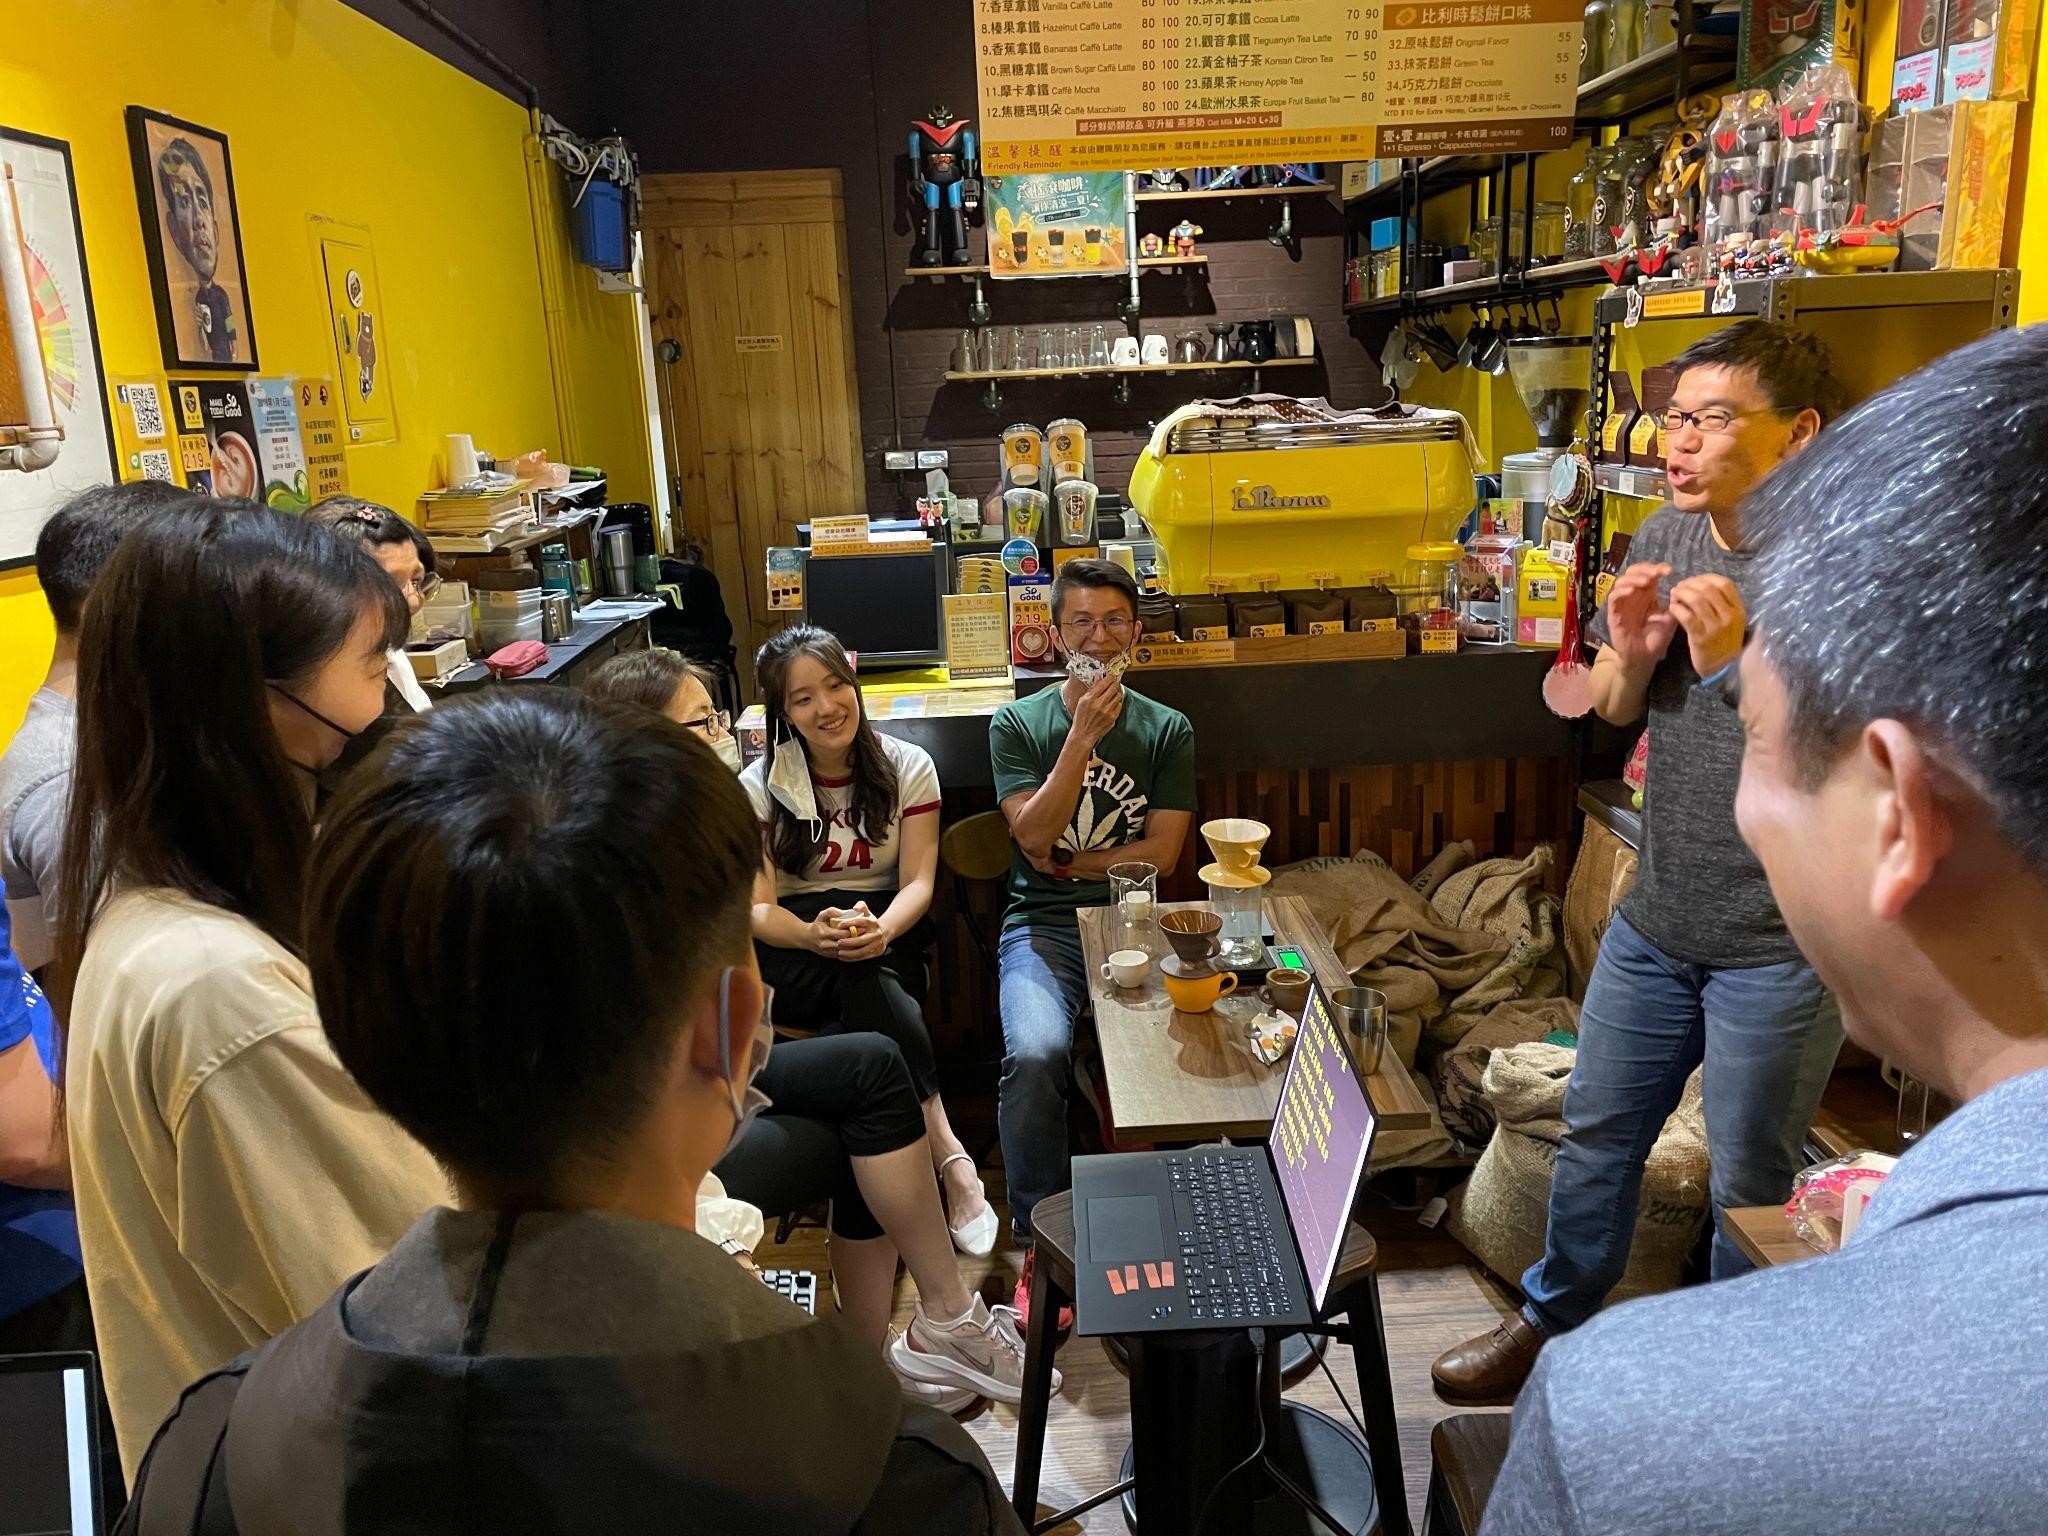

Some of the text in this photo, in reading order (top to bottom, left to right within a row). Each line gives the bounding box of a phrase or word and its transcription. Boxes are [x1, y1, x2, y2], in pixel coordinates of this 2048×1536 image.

[1347, 9, 1379, 19] 70 90
[1421, 4, 1532, 25] 比利時鬆餅口味
[1142, 17, 1179, 28] 80 100
[1185, 13, 1251, 26] 20.可可拿鐵
[1254, 15, 1300, 24] Cocoa Latte
[1043, 23, 1078, 32] Hazelnut
[1103, 21, 1122, 30] Latte
[1313, 34, 1332, 42] Latte
[1346, 30, 1378, 41] 70 90
[1558, 32, 1571, 42] 55
[983, 42, 1041, 56] 9.香蕉拿鐵
[1044, 45, 1077, 54] Bananas
[1103, 43, 1122, 51] Latte
[1142, 39, 1179, 49] 80 100
[1455, 39, 1486, 49] Original
[1185, 54, 1262, 68] 22.黃金柚子茶
[1265, 56, 1292, 65] Korean
[1295, 56, 1317, 64] Citron
[1364, 51, 1377, 61] 50
[1556, 53, 1569, 63] 55
[1142, 60, 1179, 70] 80 100
[1454, 59, 1494, 68] Green Tea
[1051, 66, 1073, 74] Brown
[1075, 65, 1095, 76] Sugar
[1118, 63, 1136, 72] Latte
[1362, 72, 1376, 81] 50
[1555, 73, 1568, 83] 55
[1142, 81, 1179, 91] 80 100
[1185, 76, 1237, 90] 23.蘋果茶
[1239, 77, 1303, 89] Honey Apple Tea
[1465, 79, 1503, 88] Chocolate
[1075, 86, 1100, 94] Mocha
[1263, 98, 1287, 107] Europe
[1288, 97, 1303, 105] Fruit
[1305, 96, 1328, 104] Basket
[1361, 92, 1374, 102] 80
[1142, 101, 1179, 112] 80 100
[1185, 96, 1261, 110] 24.歐洲水果茶
[1087, 105, 1126, 115] Macchiato
[1427, 107, 1443, 115] Extra
[1469, 105, 1494, 114] Caramel
[1530, 103, 1562, 111] Chocolate
[1550, 126, 1567, 137] 100
[1398, 143, 1432, 153] Espresso
[1439, 141, 1481, 152] Cappuccino
[988, 161, 1062, 171] Friendly Reminder
[185, 453, 204, 469] 219
[1017, 525, 1026, 533] M
[1020, 593, 1041, 602] Good
[1015, 614, 1040, 624] 219
[819, 839, 874, 874] 24
